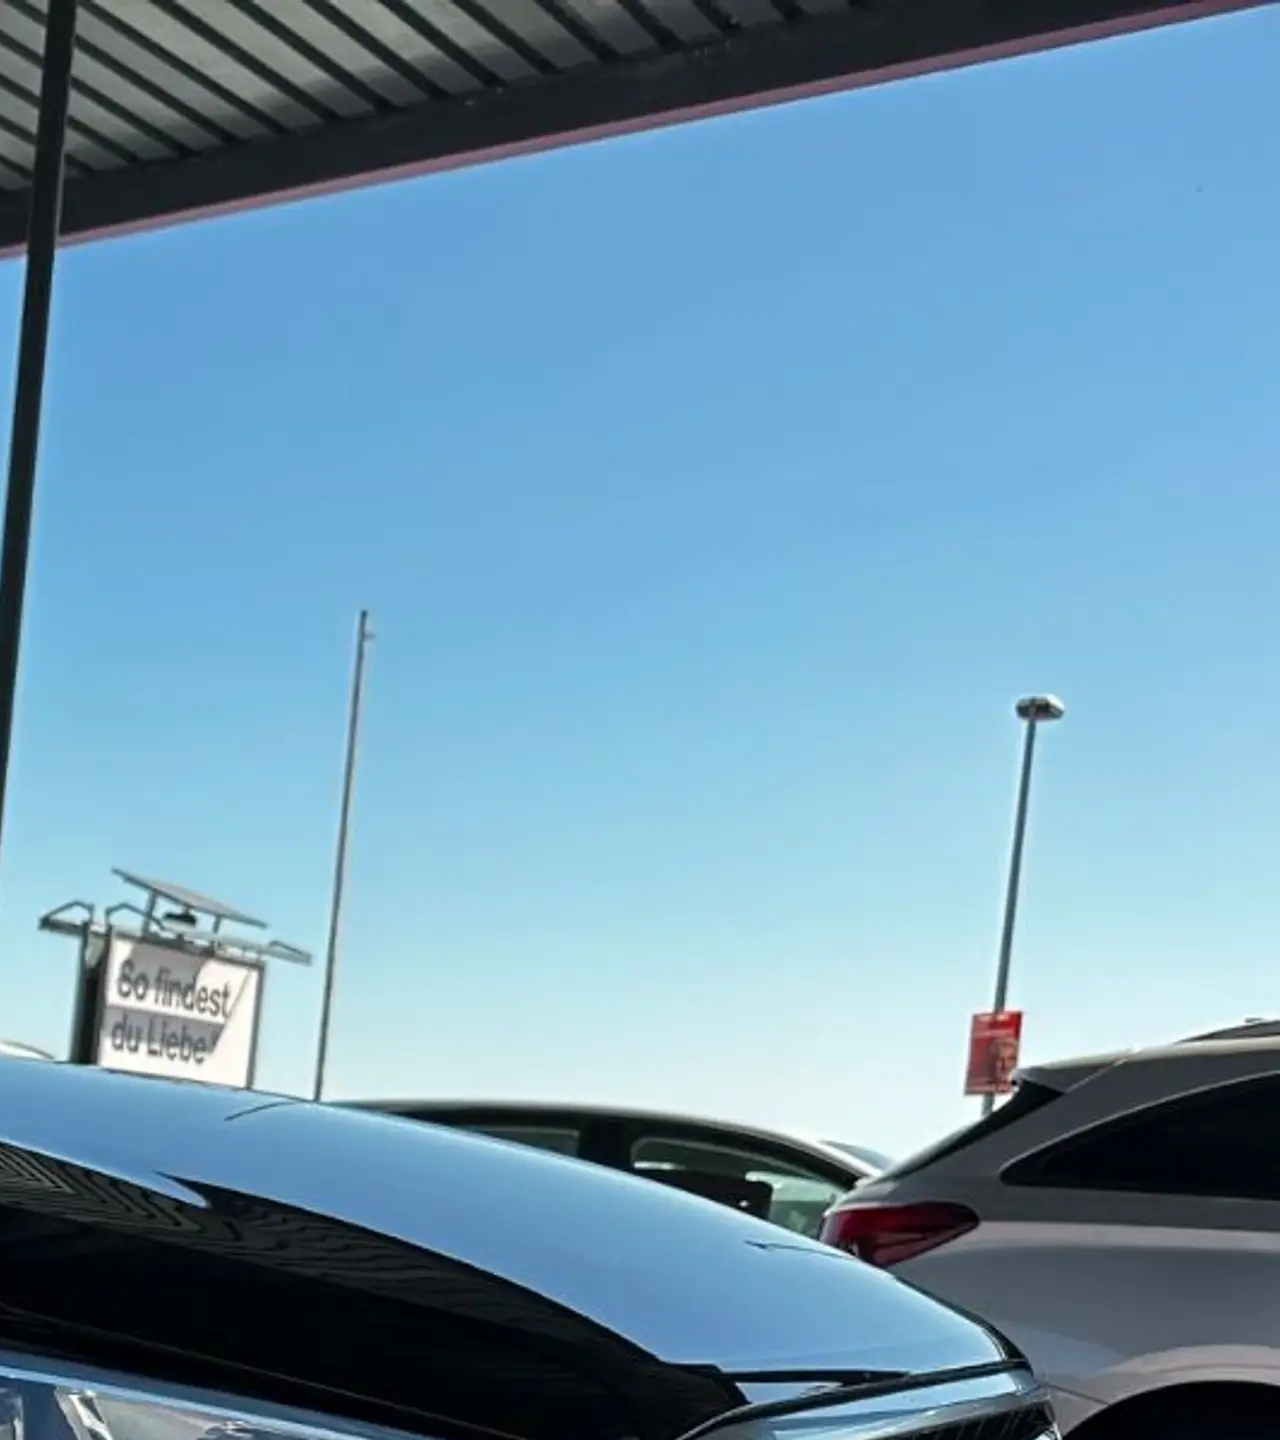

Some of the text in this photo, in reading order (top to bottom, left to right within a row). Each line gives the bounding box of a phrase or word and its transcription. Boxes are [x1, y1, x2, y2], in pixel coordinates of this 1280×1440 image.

[117, 959, 232, 1019] So findest
[111, 1011, 140, 1053] du
